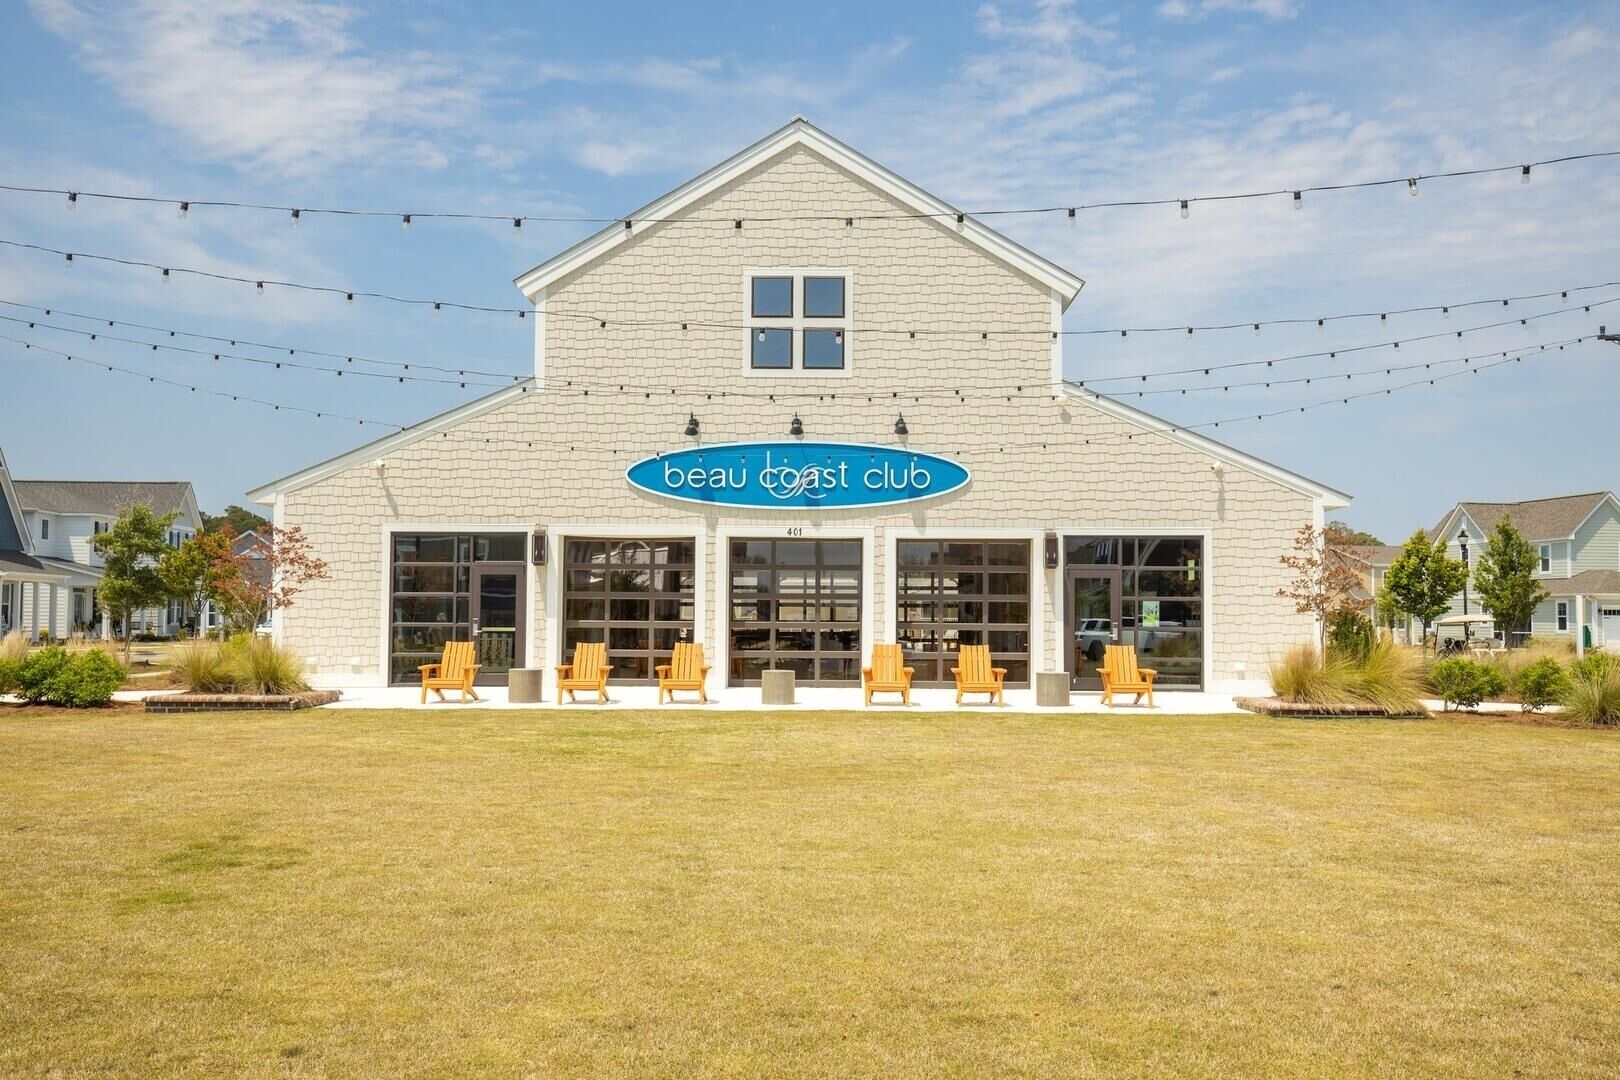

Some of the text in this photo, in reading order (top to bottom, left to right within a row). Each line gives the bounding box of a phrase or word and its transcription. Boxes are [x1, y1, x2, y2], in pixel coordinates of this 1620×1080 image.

[664, 461, 932, 490] beau coast club
[786, 527, 802, 537] 401
